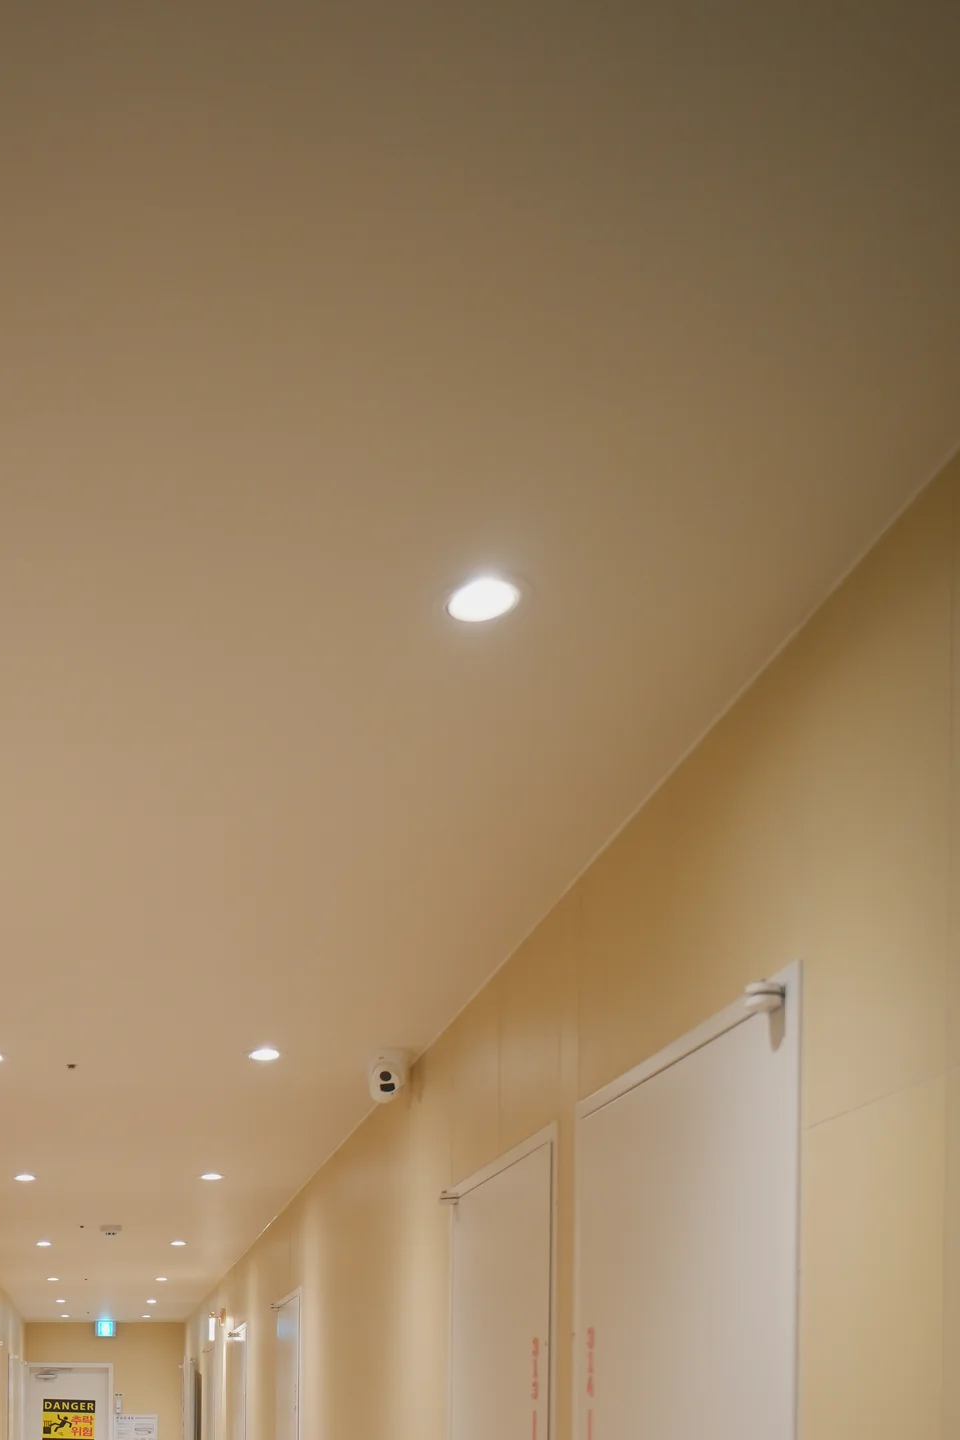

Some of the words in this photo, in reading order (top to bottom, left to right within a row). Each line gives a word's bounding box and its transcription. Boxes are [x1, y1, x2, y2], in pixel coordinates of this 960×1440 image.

[44, 1401, 94, 1411] DANGER
[71, 1415, 94, 1426] 추락
[71, 1426, 93, 1437] 위험
